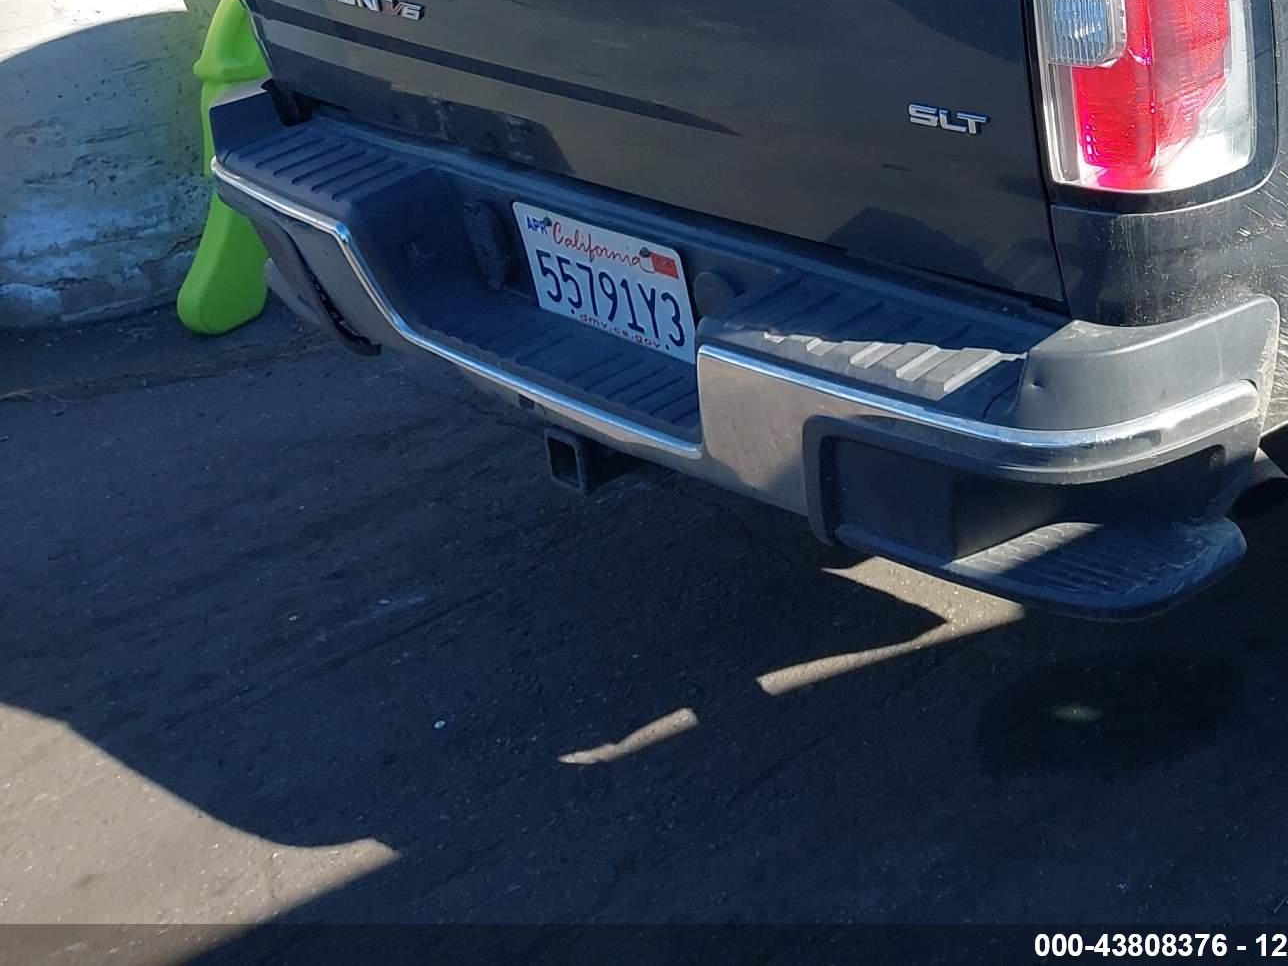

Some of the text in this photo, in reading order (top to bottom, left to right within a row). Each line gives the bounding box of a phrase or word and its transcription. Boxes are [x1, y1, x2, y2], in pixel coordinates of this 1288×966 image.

[908, 103, 989, 135] SLT
[526, 215, 550, 235] APR
[552, 221, 643, 267] California
[535, 248, 686, 347] 55791Y3
[579, 313, 661, 349] dmv.ca.gov
